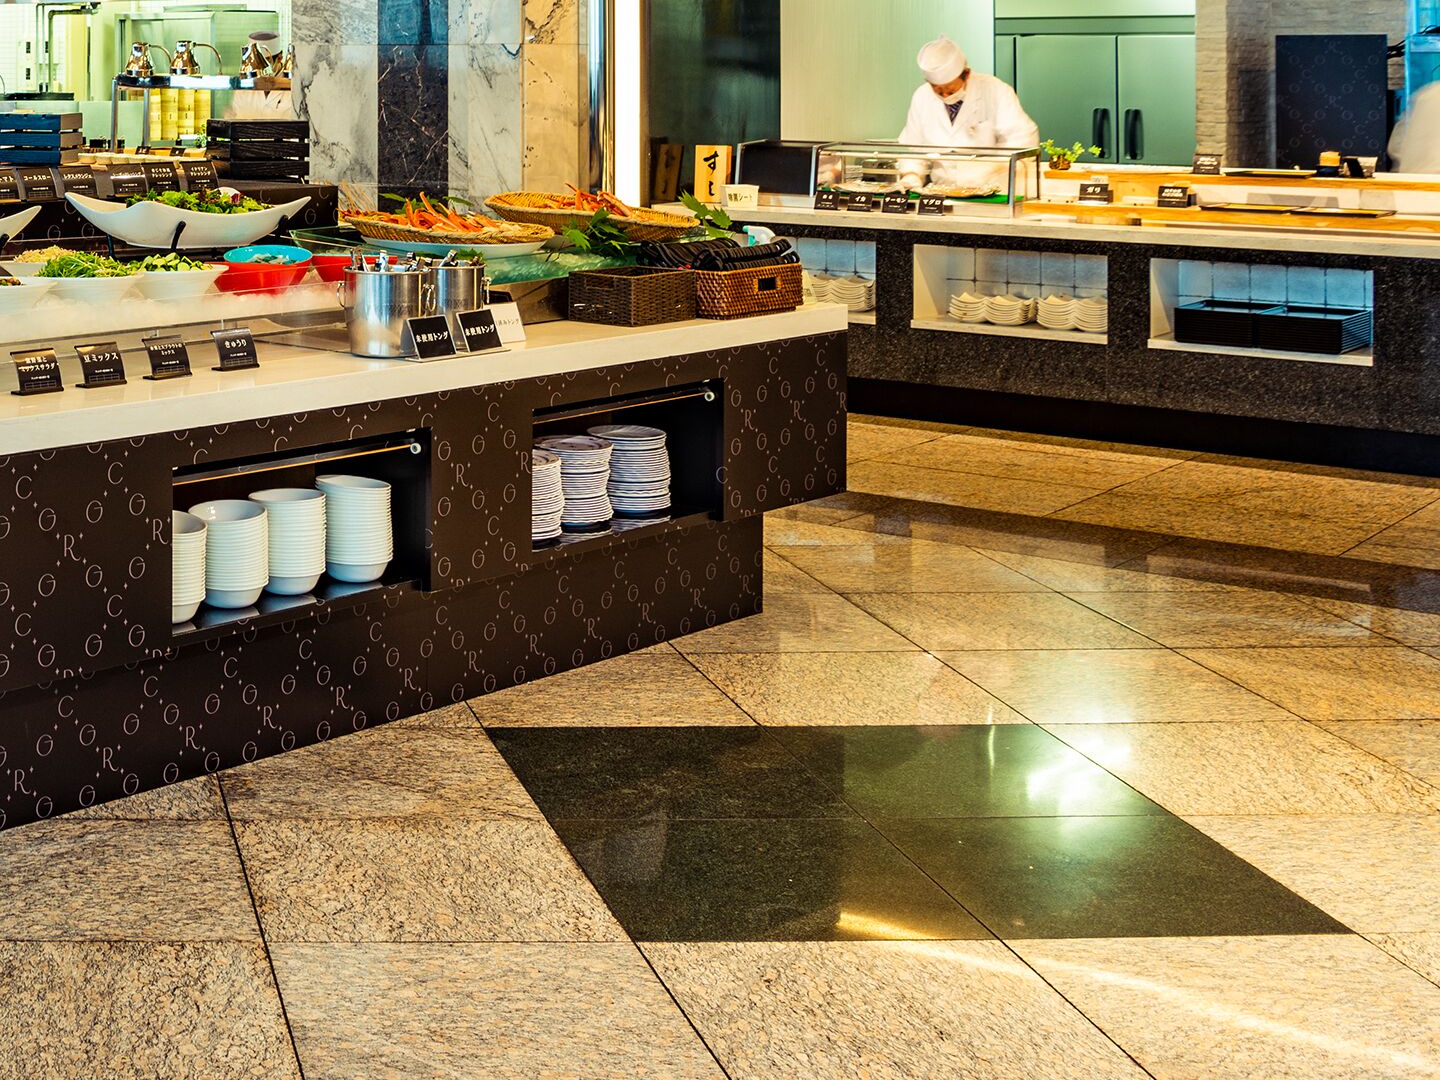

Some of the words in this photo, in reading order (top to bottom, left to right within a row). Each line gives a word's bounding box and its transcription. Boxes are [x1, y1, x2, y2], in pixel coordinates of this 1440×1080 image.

[703, 151, 719, 196] すし
[884, 196, 907, 204] サーモン
[922, 198, 942, 206] マグロ
[464, 324, 495, 337] 未使用トング
[415, 331, 448, 343] 未使用トング
[224, 339, 247, 349] きゅうり
[83, 352, 119, 363] 豆ミックス
